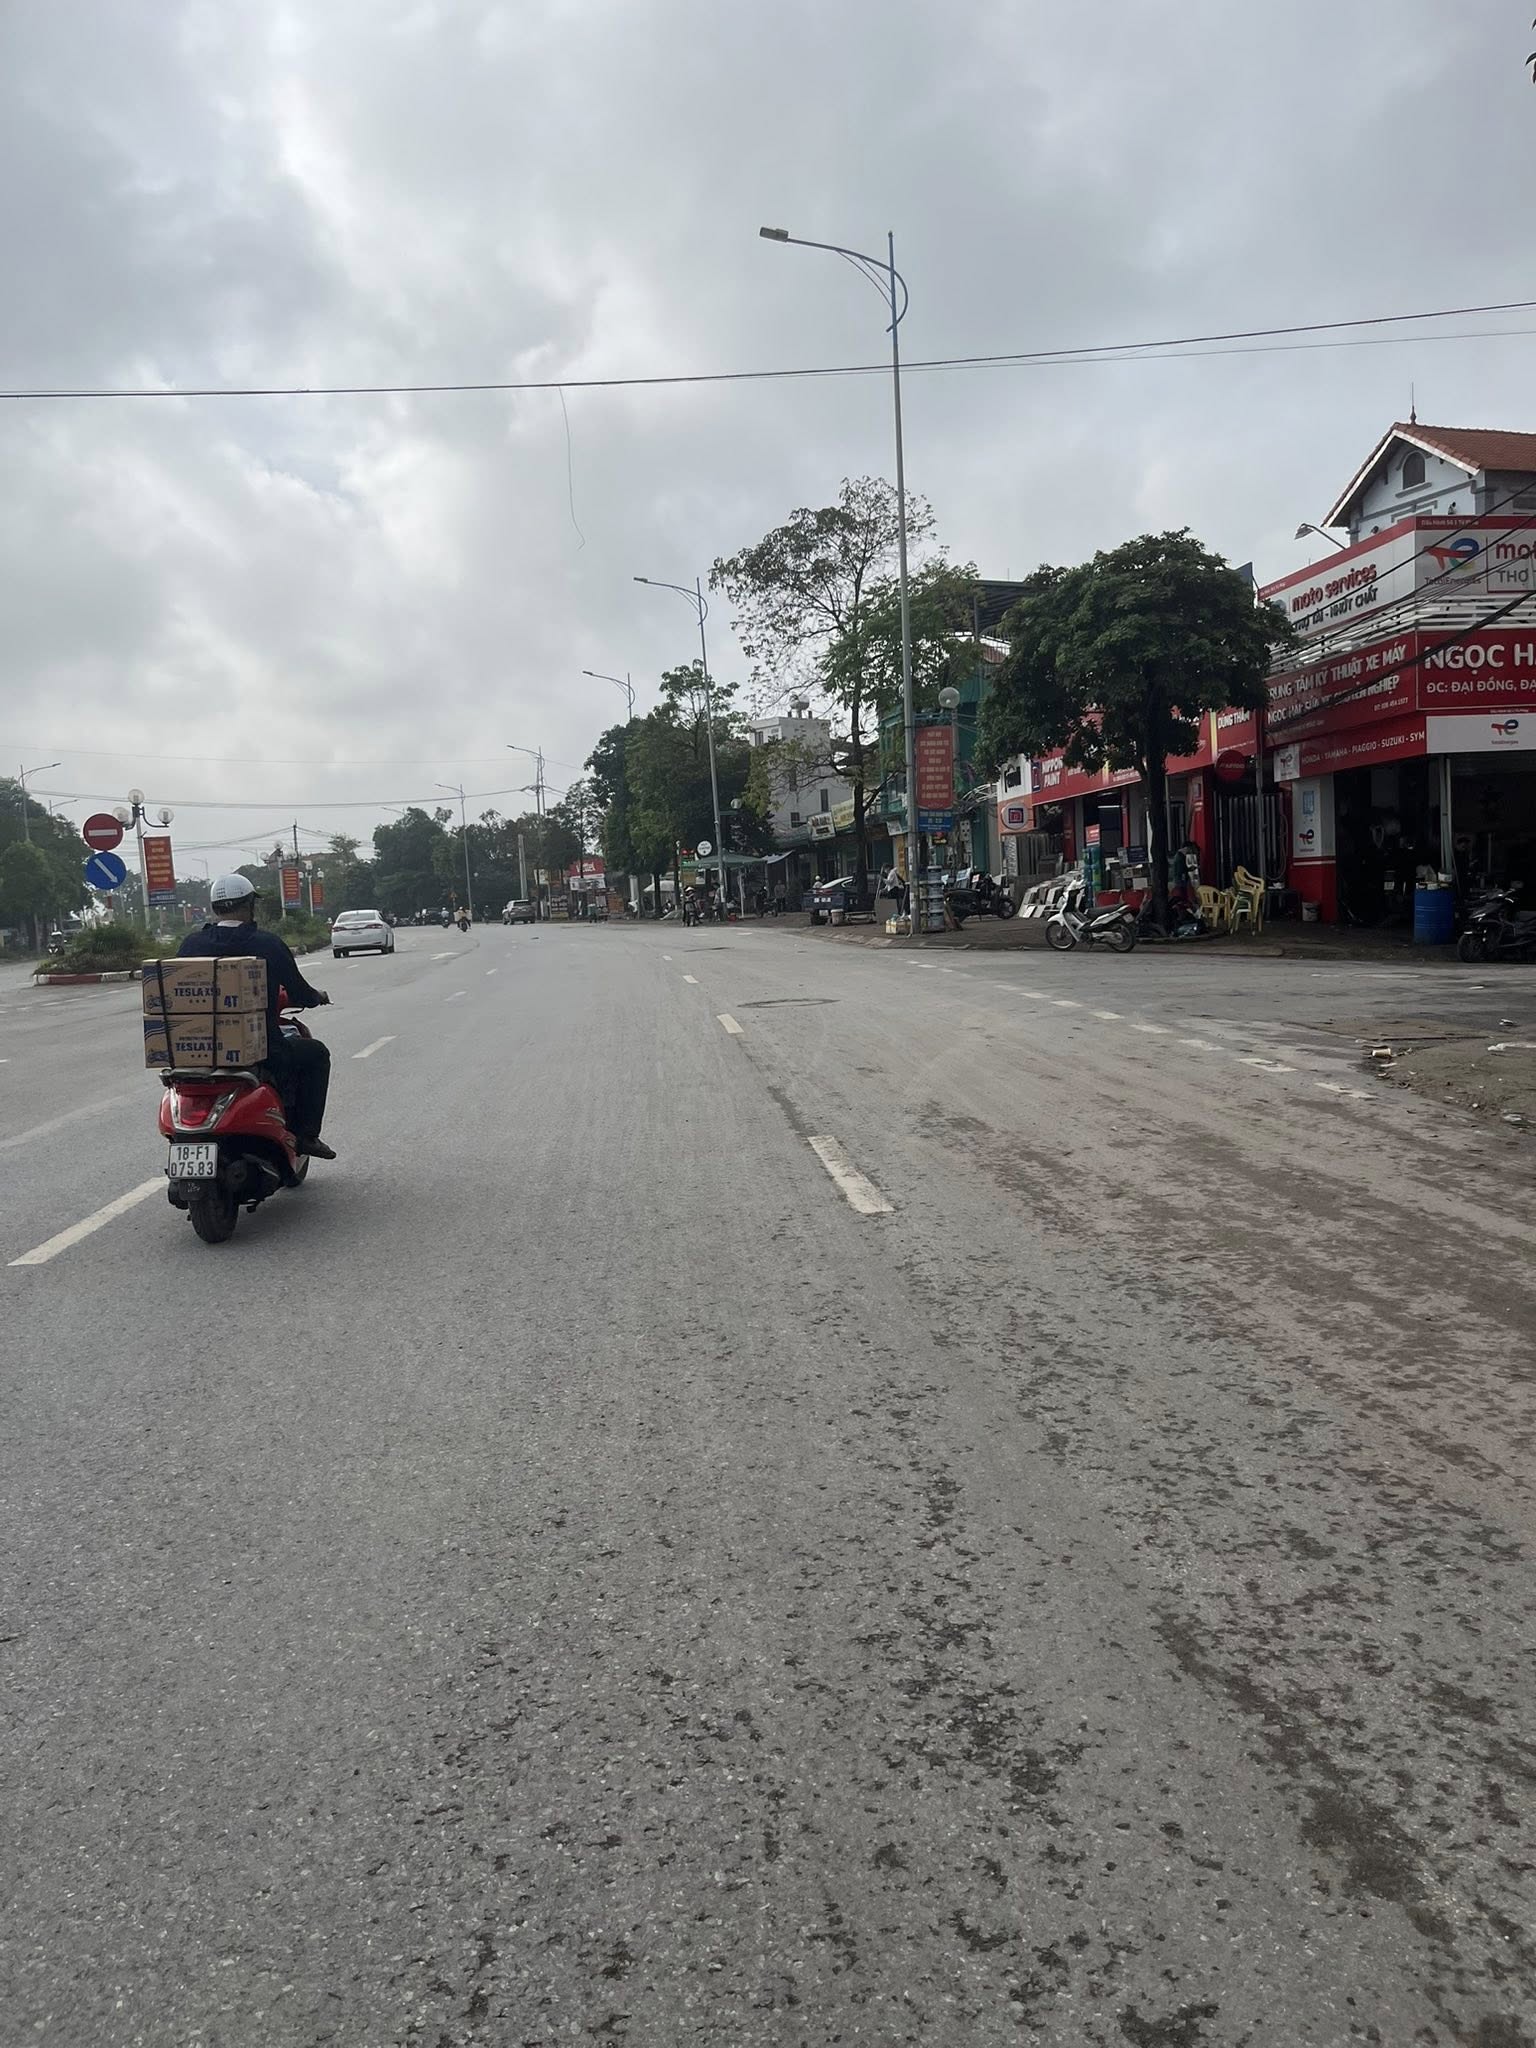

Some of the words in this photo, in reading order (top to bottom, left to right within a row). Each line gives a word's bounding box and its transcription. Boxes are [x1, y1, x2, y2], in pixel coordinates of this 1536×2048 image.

[1496, 568, 1529, 586] THỢ
[1292, 587, 1323, 613] moto
[1325, 563, 1378, 598] services
[1330, 657, 1364, 682] THUẬT
[1365, 653, 1379, 671] XE
[1383, 642, 1407, 667] MÁY
[1424, 644, 1505, 675] NGỌC
[1514, 643, 1536, 667] H
[1426, 682, 1448, 693] ĐC:
[1451, 681, 1473, 695] ĐẠI
[1381, 735, 1405, 748] SUZUKI
[1410, 730, 1425, 742] SYM
[174, 987, 204, 997] TESLA
[224, 995, 239, 1008] 4T
[176, 1042, 206, 1052] TESLA
[226, 1050, 241, 1063] 4T
[177, 1145, 209, 1160] 18-F1
[171, 1161, 214, 1176] 075.83
